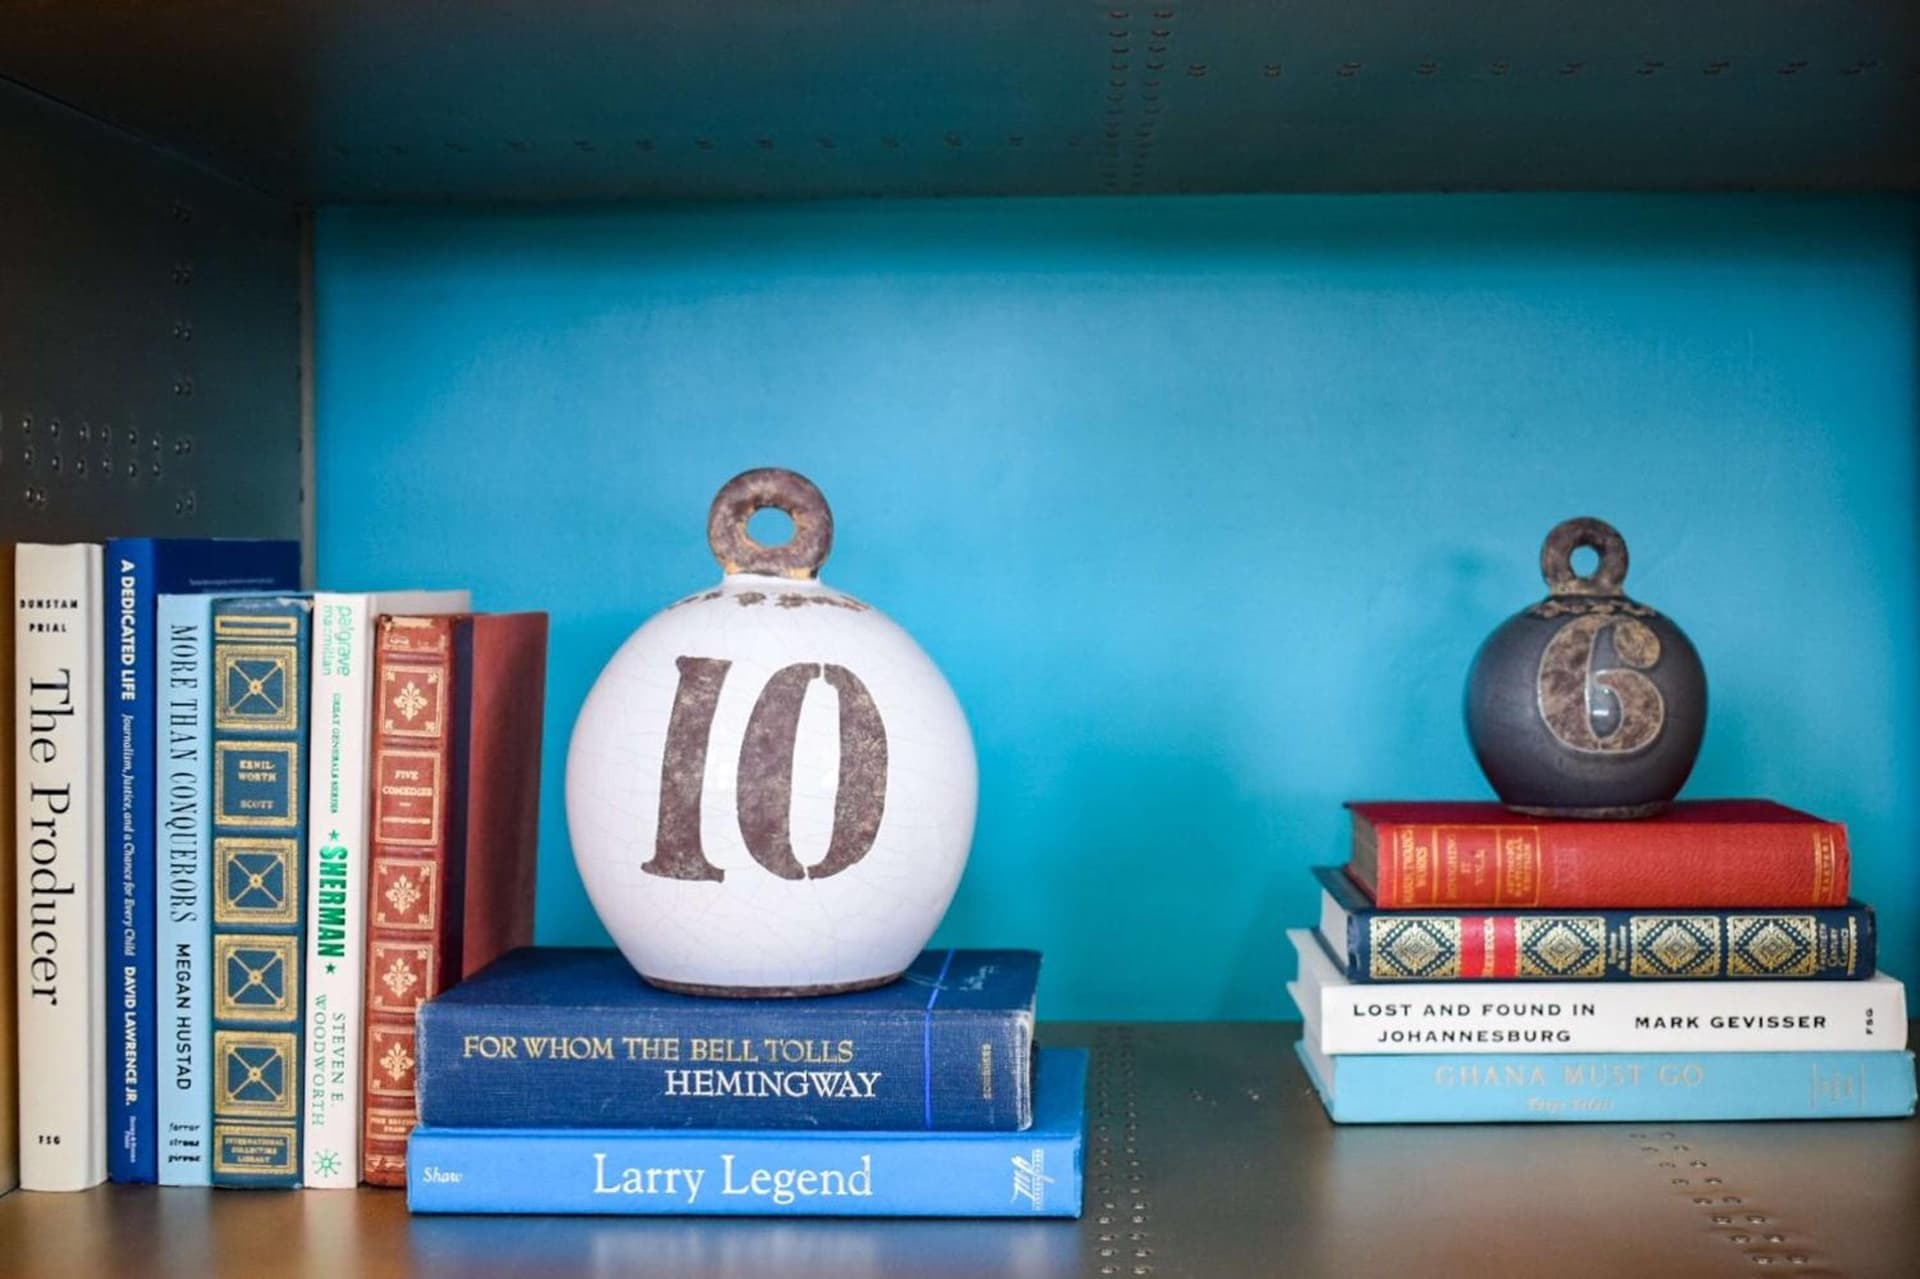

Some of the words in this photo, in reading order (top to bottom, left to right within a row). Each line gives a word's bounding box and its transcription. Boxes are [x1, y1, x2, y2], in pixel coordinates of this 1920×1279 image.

[121, 559, 135, 573] A
[29, 623, 67, 633] PRIAL
[121, 577, 135, 665] DEDICATED
[336, 604, 352, 677] palgrave
[170, 624, 198, 688] MORE
[121, 669, 135, 700] LIFE
[1537, 613, 1665, 755] 6
[30, 668, 74, 764] The
[170, 699, 198, 762] THAN
[121, 714, 134, 771] Journalism,
[641, 655, 889, 883] 10
[121, 773, 134, 811] Justice,
[123, 812, 134, 832] and
[122, 842, 135, 881] Chance
[166, 772, 198, 923] CONQUERORS
[30, 783, 75, 1006] Producer
[122, 882, 135, 897] for
[318, 845, 348, 957] SHERMAN
[122, 899, 135, 927] Every
[123, 928, 135, 957] Child
[123, 966, 136, 1008] DAVID
[176, 943, 191, 1009] MEGAN
[1353, 1004, 1412, 1017] LOST
[1423, 1004, 1471, 1017] AND
[1482, 1004, 1562, 1017] FOUND
[1573, 1004, 1595, 1017] IN
[1635, 1016, 1700, 1029] MARK
[1711, 1016, 1827, 1029] GEVISSER
[1865, 1008, 1874, 1035] FSG
[123, 1011, 137, 1084] LAWRENCE
[176, 1016, 192, 1091] HUSTAD
[331, 1013, 345, 1084] STEVEN
[463, 1035, 517, 1060] FOR
[521, 1036, 614, 1061] WHOM
[622, 1037, 680, 1062] THE
[690, 1038, 759, 1063] BELL
[765, 1040, 855, 1064] TOLLS
[1378, 1030, 1572, 1043] JOHANNESBURG
[311, 994, 328, 1125] WOODWORTH
[1435, 1063, 1546, 1088] GHANA
[1563, 1063, 1643, 1087] MUST
[1656, 1062, 1705, 1087] GO
[123, 1087, 137, 1106] JR.
[664, 1070, 882, 1099] HEMINGWAY
[422, 1166, 463, 1184] Shaw
[593, 1153, 704, 1204] Larry
[721, 1153, 873, 1204] Legend
